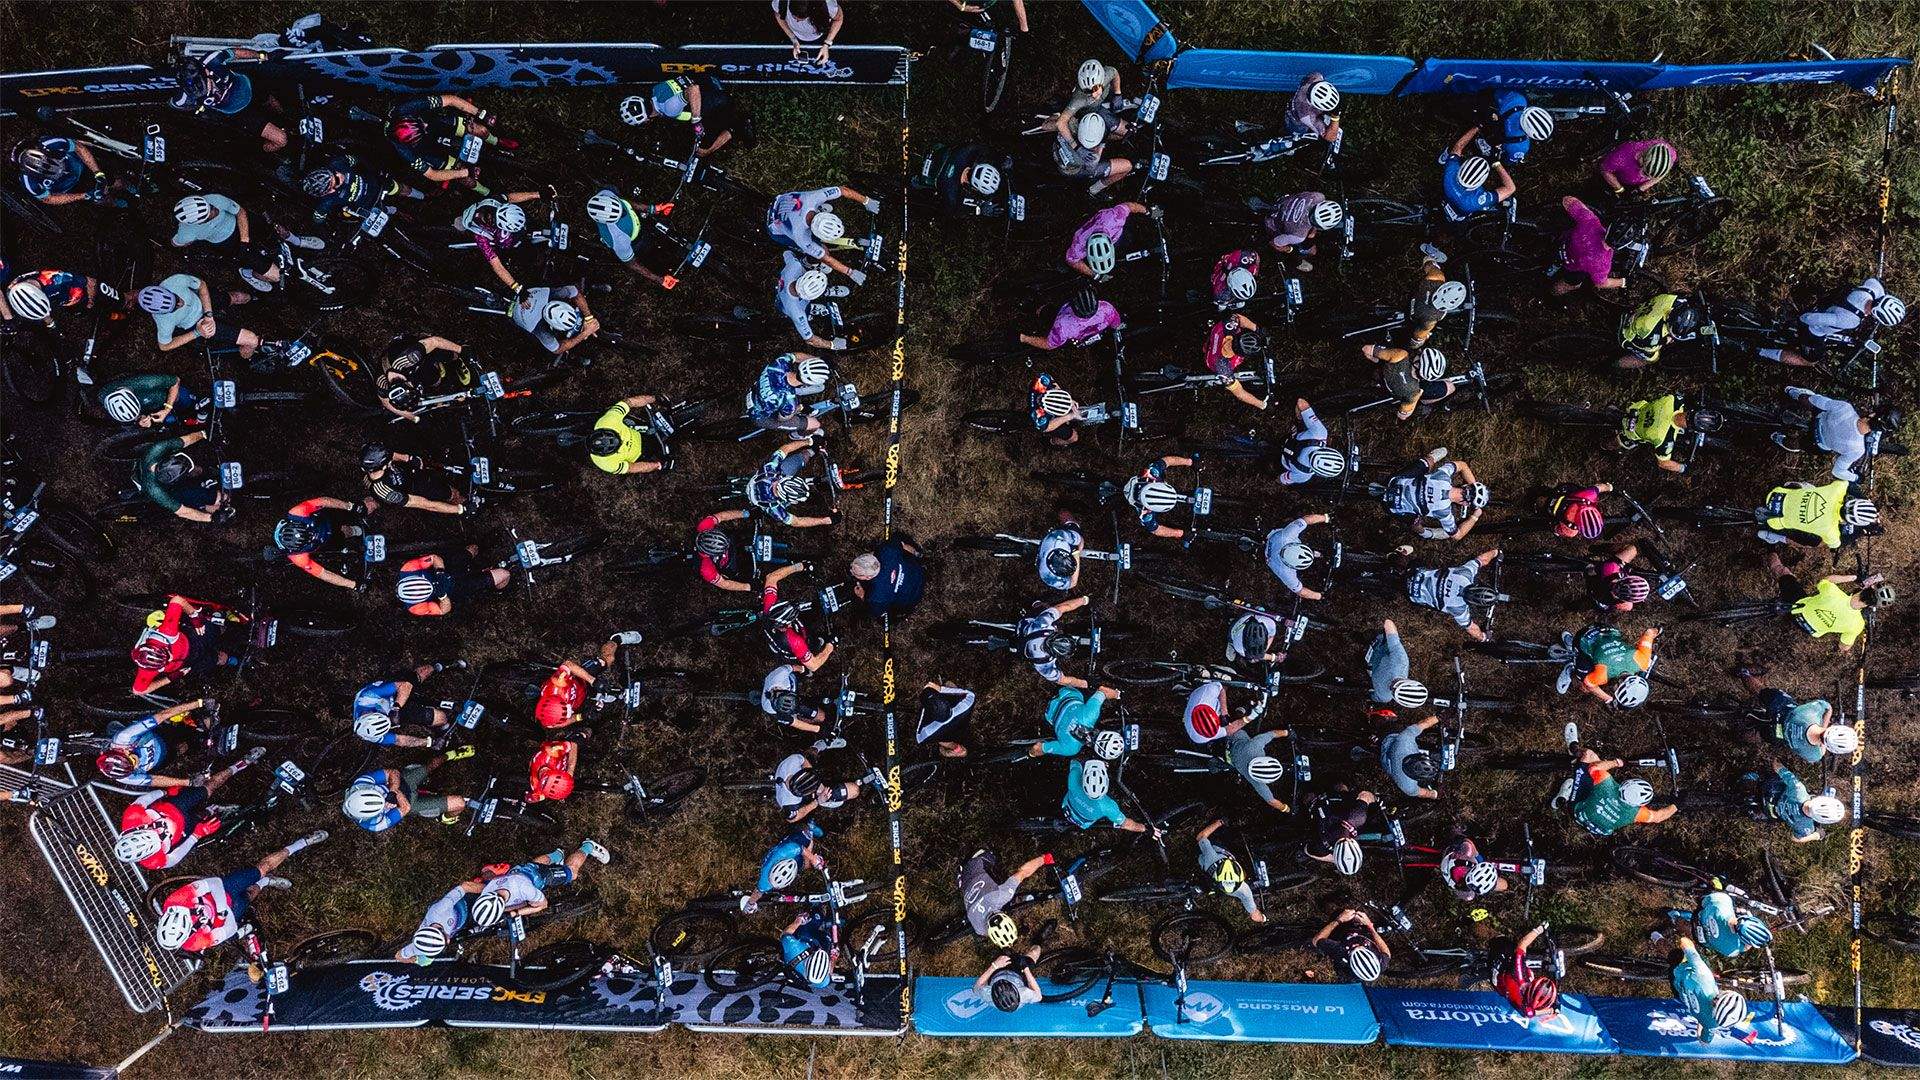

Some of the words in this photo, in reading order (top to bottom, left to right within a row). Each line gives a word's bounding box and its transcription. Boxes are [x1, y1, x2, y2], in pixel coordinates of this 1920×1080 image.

[892, 390, 900, 416] SERIES
[1799, 491, 1811, 524] MRTHN
[887, 713, 895, 739] SERIES
[47, 742, 55, 760] 219-2
[892, 821, 900, 847] SERIES
[394, 985, 492, 1000] SERIES
[493, 987, 546, 1004] EPIC
[1238, 1002, 1319, 1014] Massana
[1325, 1005, 1345, 1015] La
[1402, 1000, 1501, 1013] visitandorra.com
[1406, 1009, 1529, 1030] Andorra
